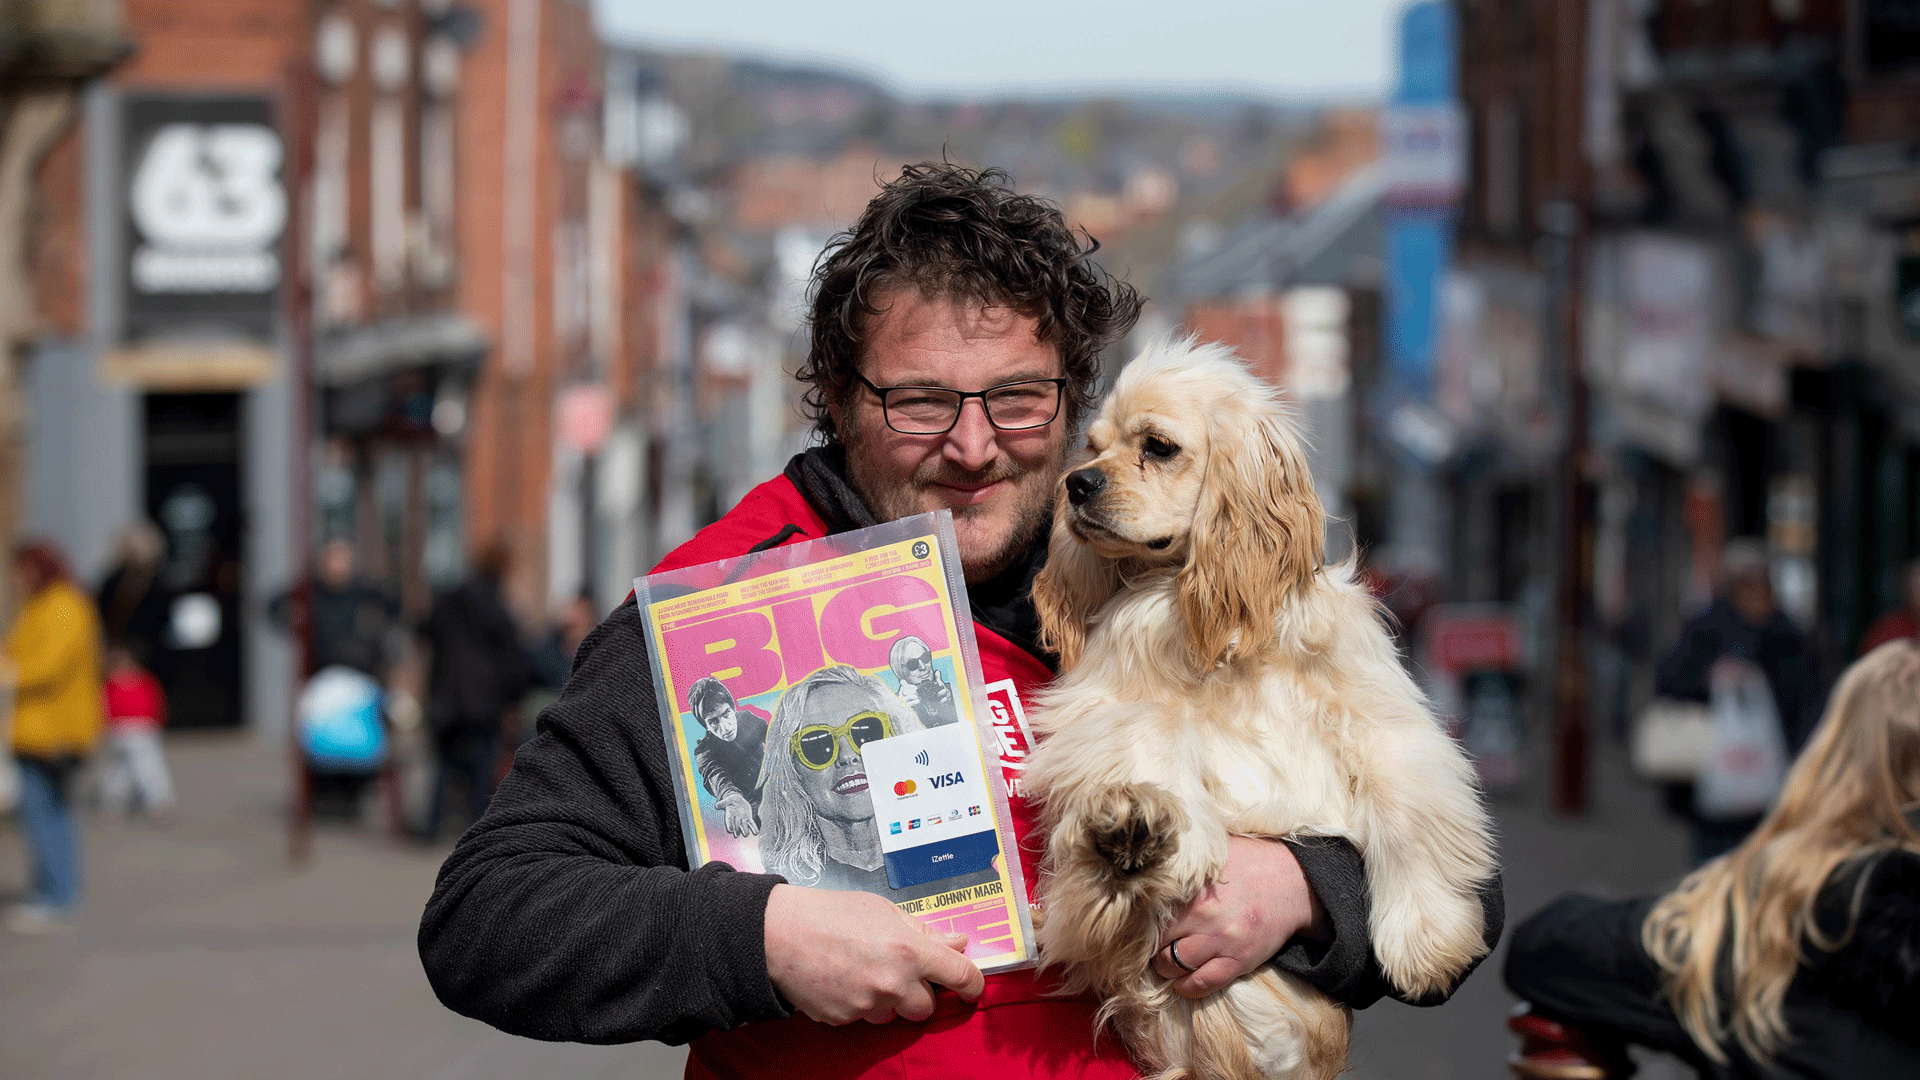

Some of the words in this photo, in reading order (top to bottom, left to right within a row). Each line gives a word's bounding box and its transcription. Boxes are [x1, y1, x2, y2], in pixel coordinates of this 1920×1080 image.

[914, 543, 927, 557] £3
[662, 622, 676, 631] THE
[662, 575, 950, 714] BIG
[927, 771, 965, 789] VISA
[932, 853, 954, 863] iZettle
[925, 898, 933, 910] &
[934, 889, 972, 908] JOHNNY
[974, 882, 1004, 899] MARR
